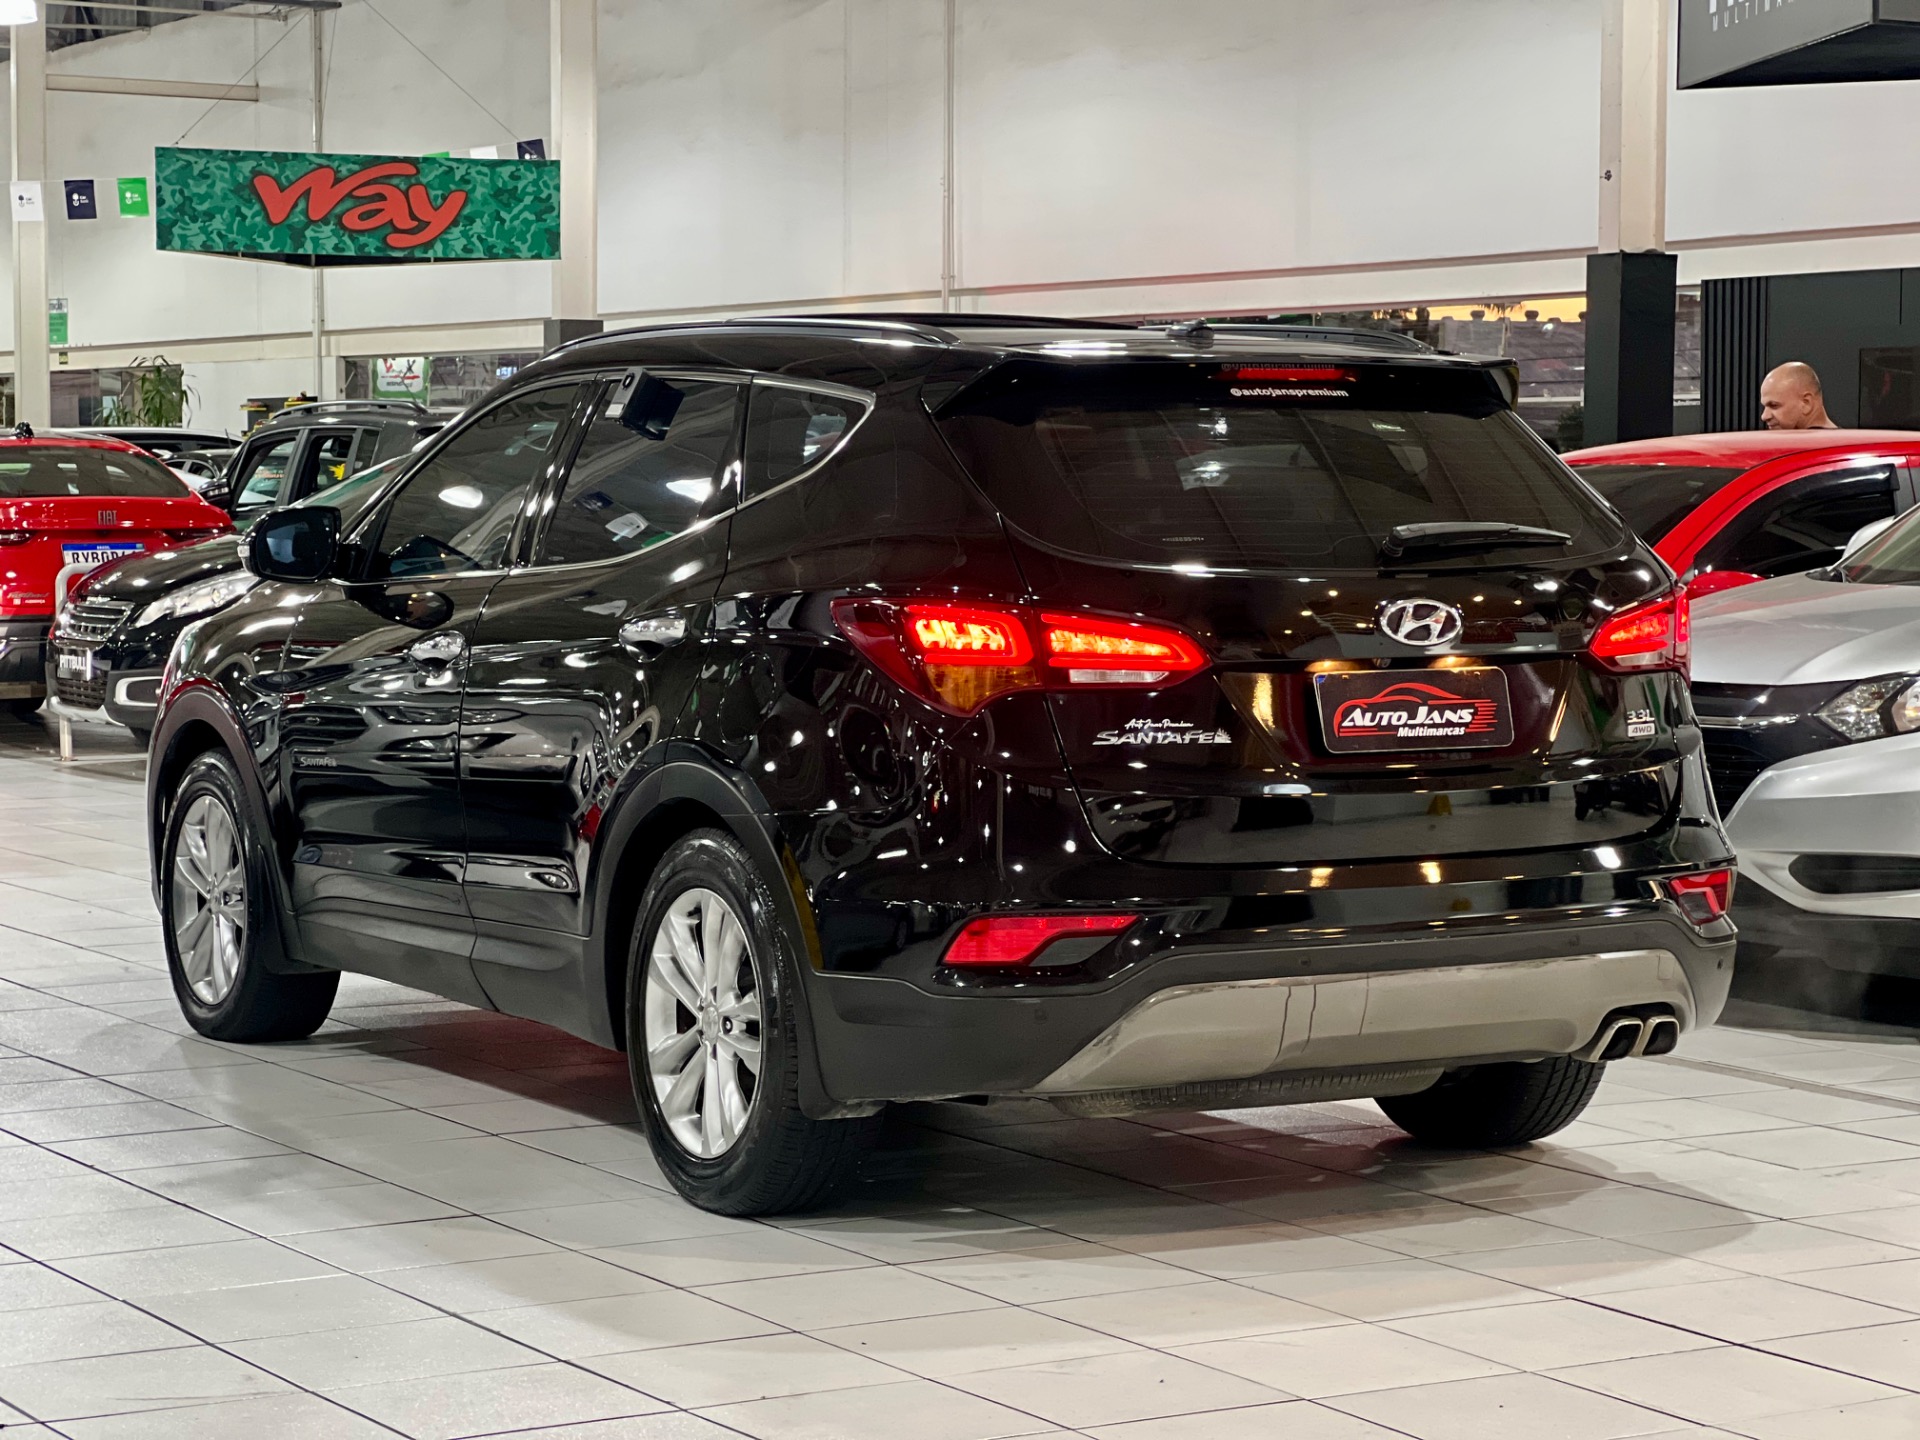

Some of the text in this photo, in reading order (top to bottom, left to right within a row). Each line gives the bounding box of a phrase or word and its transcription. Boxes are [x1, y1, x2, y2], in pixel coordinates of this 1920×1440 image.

[253, 162, 468, 248] Way
[1230, 387, 1349, 397] @autojanspremium
[97, 510, 117, 525] FIAT
[1397, 726, 1466, 737] Multimarcas
[1632, 725, 1652, 734] 4WD
